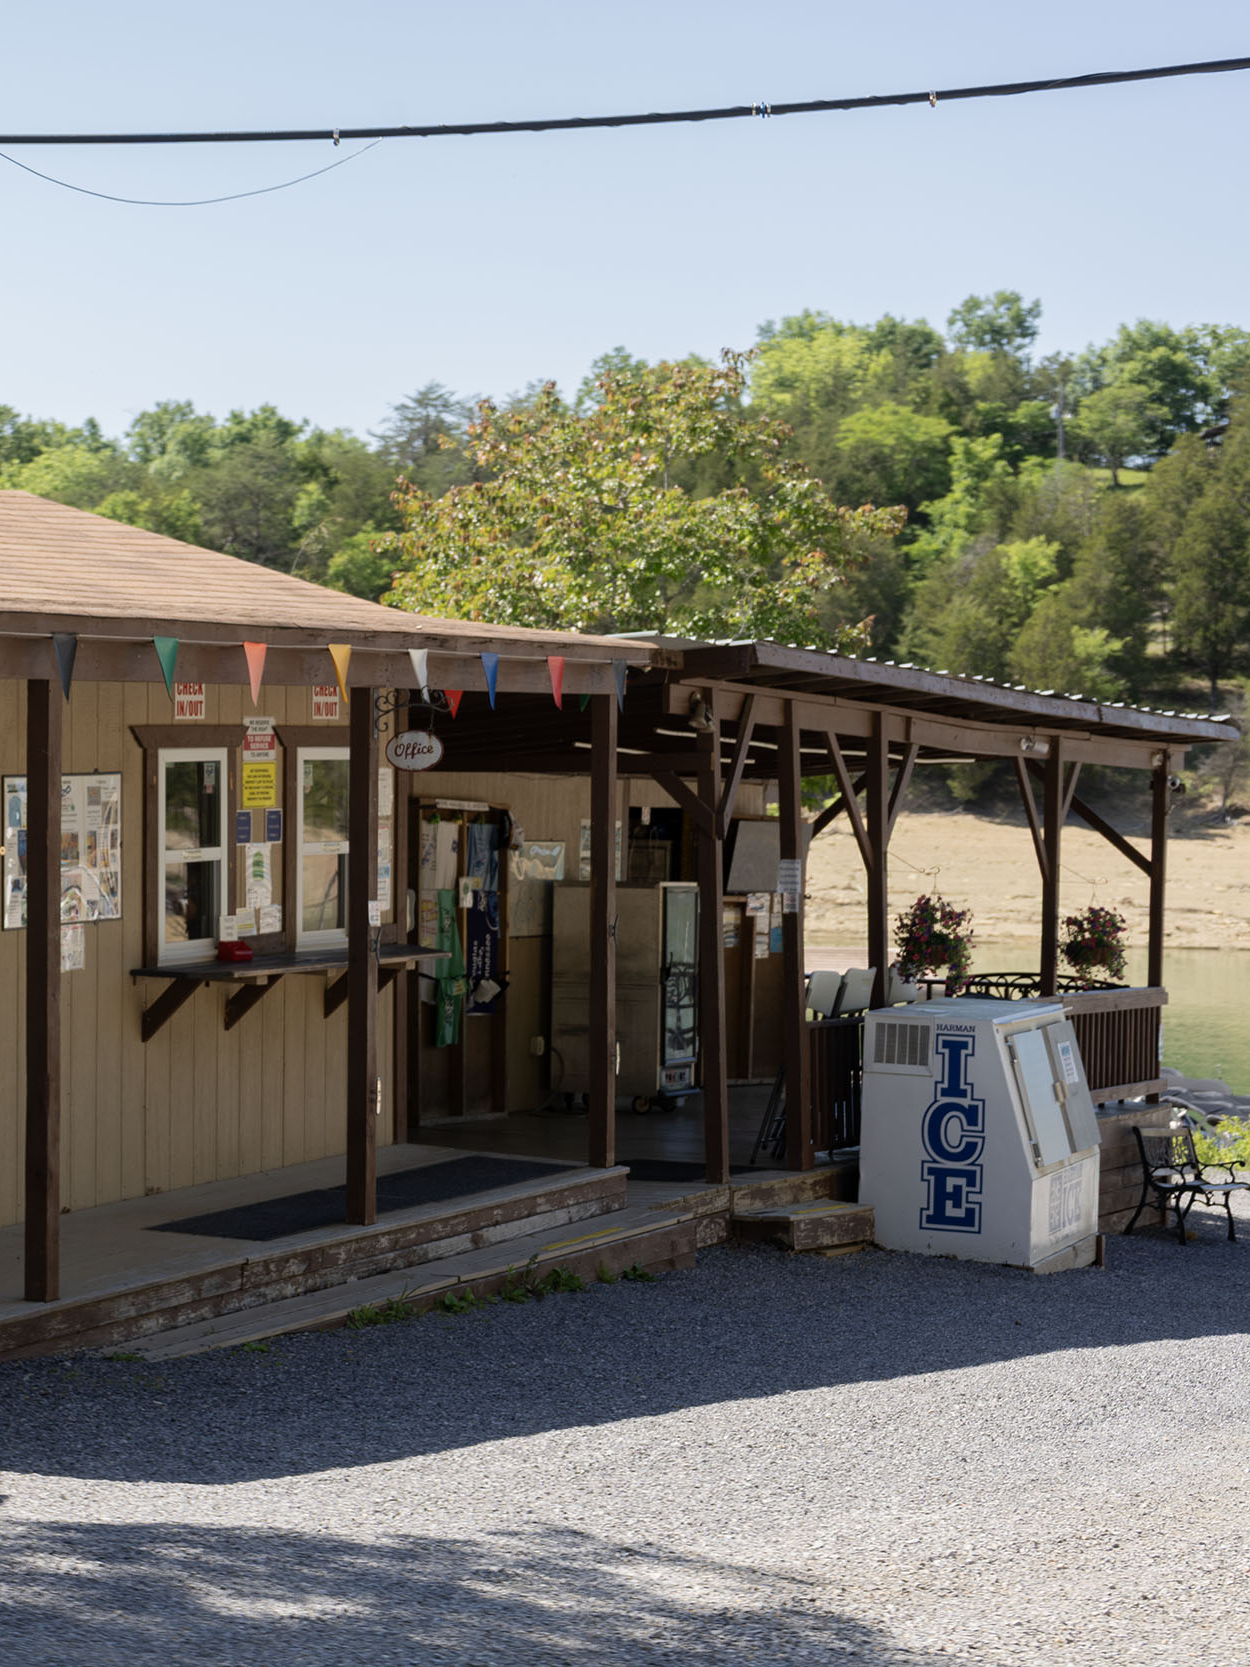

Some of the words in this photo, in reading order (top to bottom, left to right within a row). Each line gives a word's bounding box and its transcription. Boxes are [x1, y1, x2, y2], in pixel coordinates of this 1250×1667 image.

[176, 682, 203, 696] CHECK
[314, 685, 338, 697] CHECK
[176, 700, 203, 717] IN/OUT
[314, 701, 338, 717] IN/OUT
[394, 742, 434, 760] Office
[936, 1023, 976, 1032] HARMAN
[919, 1033, 986, 1234] ICE
